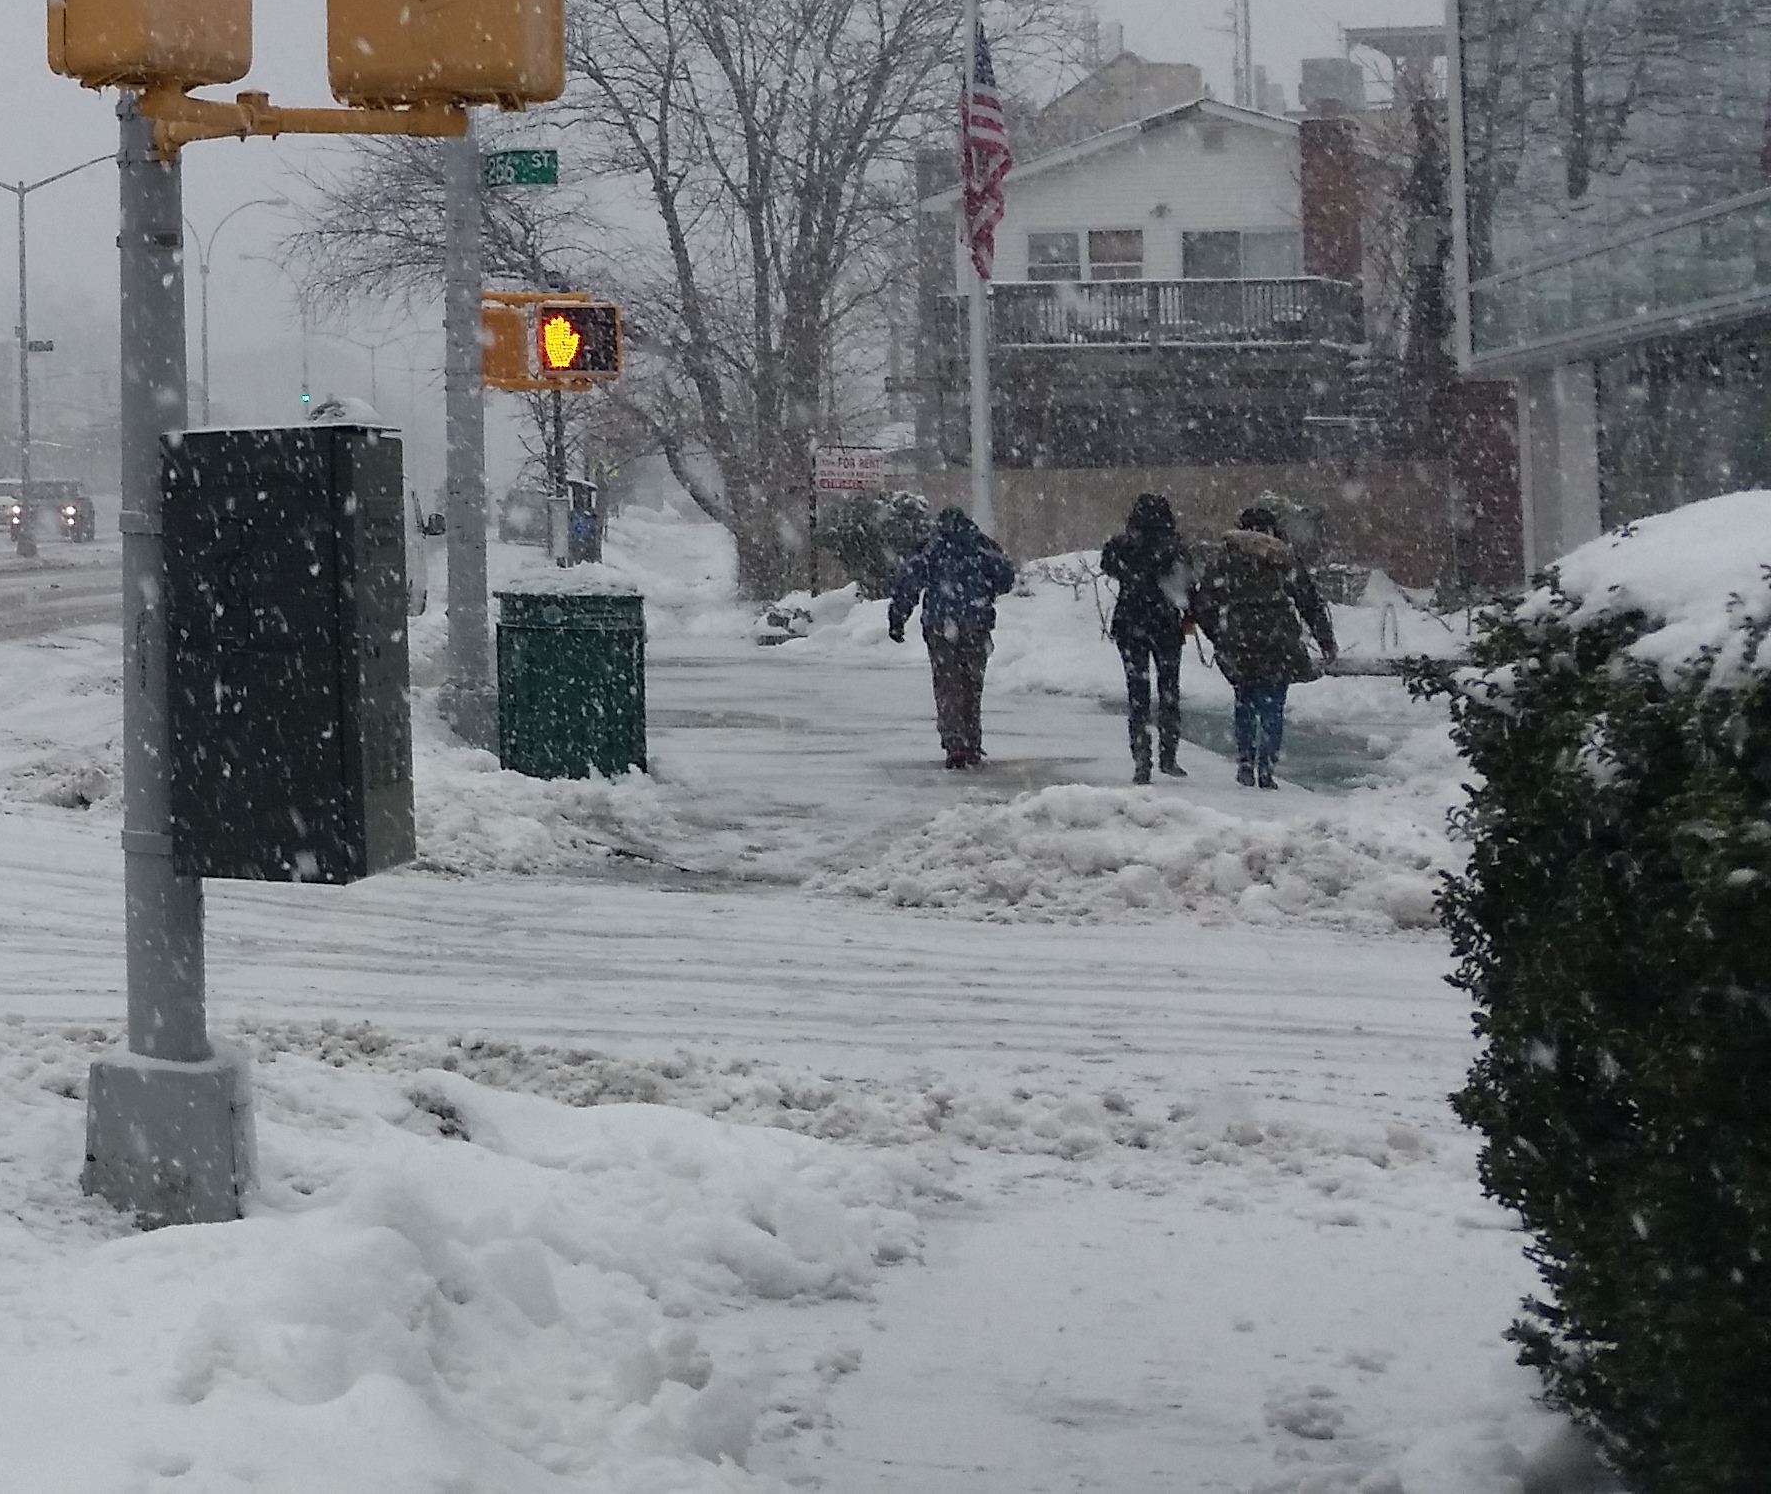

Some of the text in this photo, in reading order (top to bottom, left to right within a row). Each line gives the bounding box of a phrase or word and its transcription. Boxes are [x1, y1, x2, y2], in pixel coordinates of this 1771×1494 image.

[488, 153, 550, 184] 256 ST
[838, 457, 855, 469] FOR
